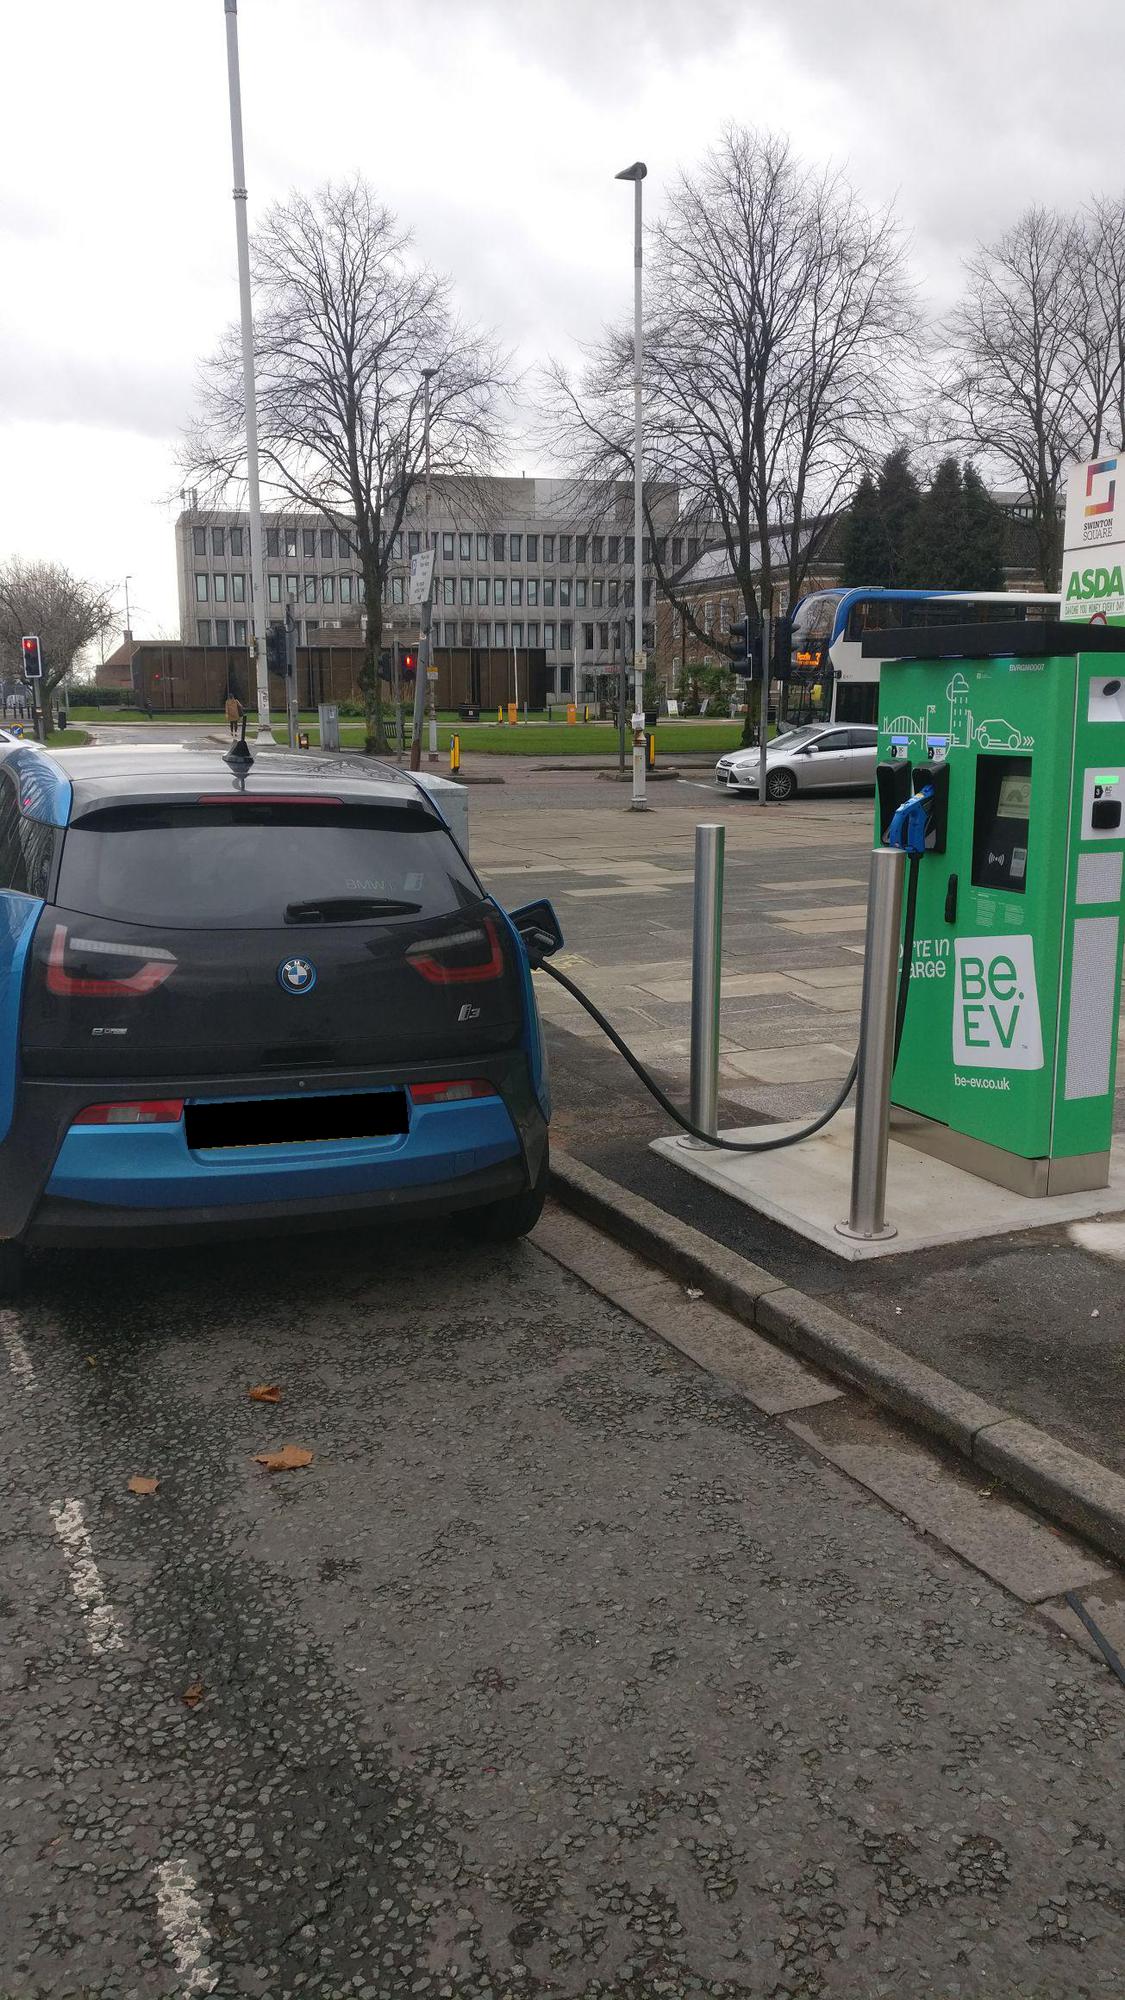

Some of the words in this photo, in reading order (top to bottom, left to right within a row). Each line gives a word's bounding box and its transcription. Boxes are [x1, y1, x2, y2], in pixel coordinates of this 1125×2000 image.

[1084, 519, 1113, 530] SWINTON
[1083, 528, 1113, 541] SQUARE
[1066, 566, 1124, 601] ASDA
[1103, 601, 1115, 612] EVERY
[960, 955, 1024, 1001] Be.
[963, 1004, 1020, 1048] EV
[954, 1073, 1010, 1090] be-ev.co.uk
